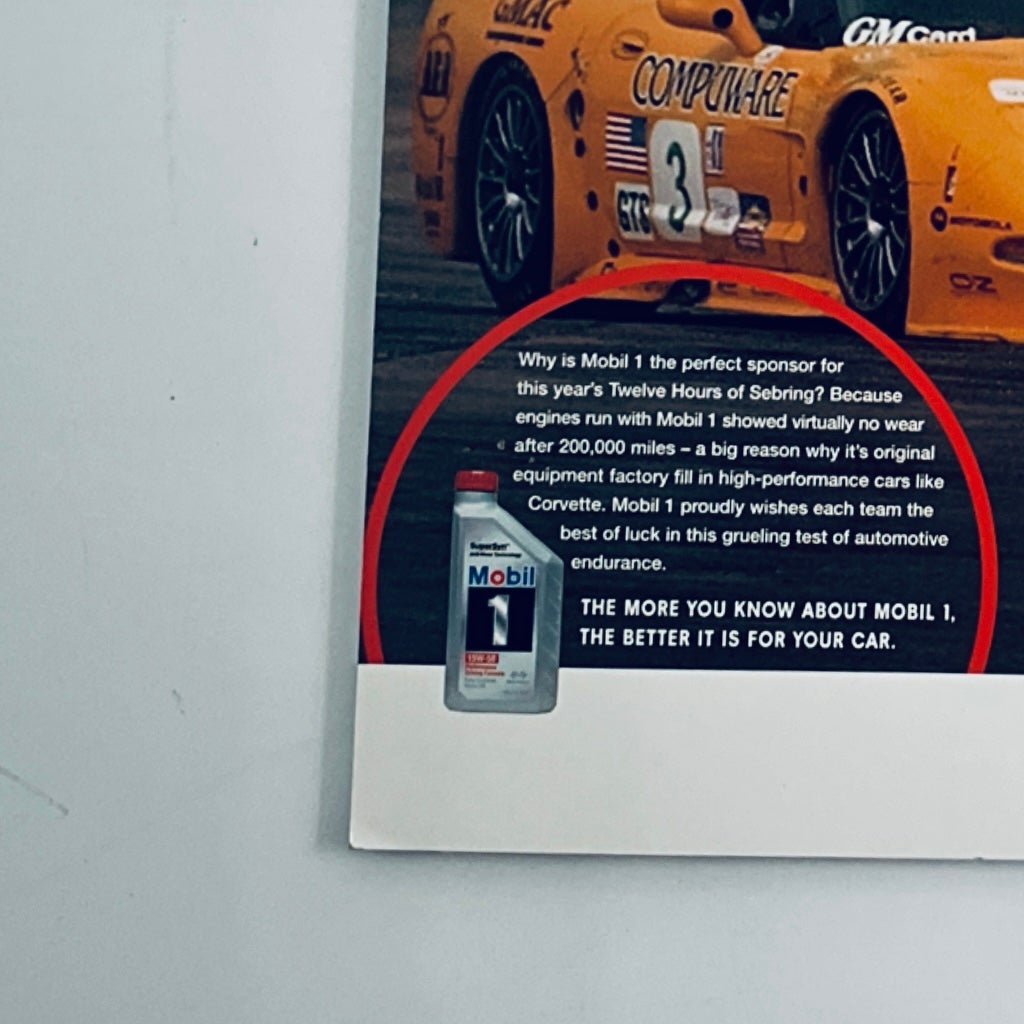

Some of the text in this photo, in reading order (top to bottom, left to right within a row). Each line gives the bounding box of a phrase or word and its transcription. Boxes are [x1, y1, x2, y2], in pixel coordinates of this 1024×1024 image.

[633, 54, 799, 118] COMPUWARE
[666, 141, 692, 233] 3
[518, 351, 845, 375] Why is Mobil 1 the perfect sponsor for
[516, 379, 903, 405] this year's Twelve Hours of Sebring? Because
[515, 409, 926, 434] engines run with Mobil 1 showed virtually no wear
[514, 437, 555, 454] after
[558, 438, 626, 456] 200,000
[630, 439, 676, 456] miles
[695, 443, 707, 456] a
[711, 440, 738, 461] big
[742, 445, 801, 458] reason
[805, 443, 841, 463] why
[845, 443, 869, 460] it's
[873, 444, 936, 464] original
[512, 466, 945, 490] equipment factory fill in high-performance cars like
[528, 495, 934, 518] Corvette. Mobil 1 proudly wishes each team the
[560, 524, 949, 548] best of luck in this grueling test of automotive
[571, 554, 667, 571] endurance.
[469, 565, 535, 585] Mobil
[488, 594, 509, 646] 1
[581, 598, 956, 623] THE MORE YOU KNOW ABOUT MOBIL 1,
[579, 627, 896, 650] THE BETTER IT IS FOR YOUR CAR.
